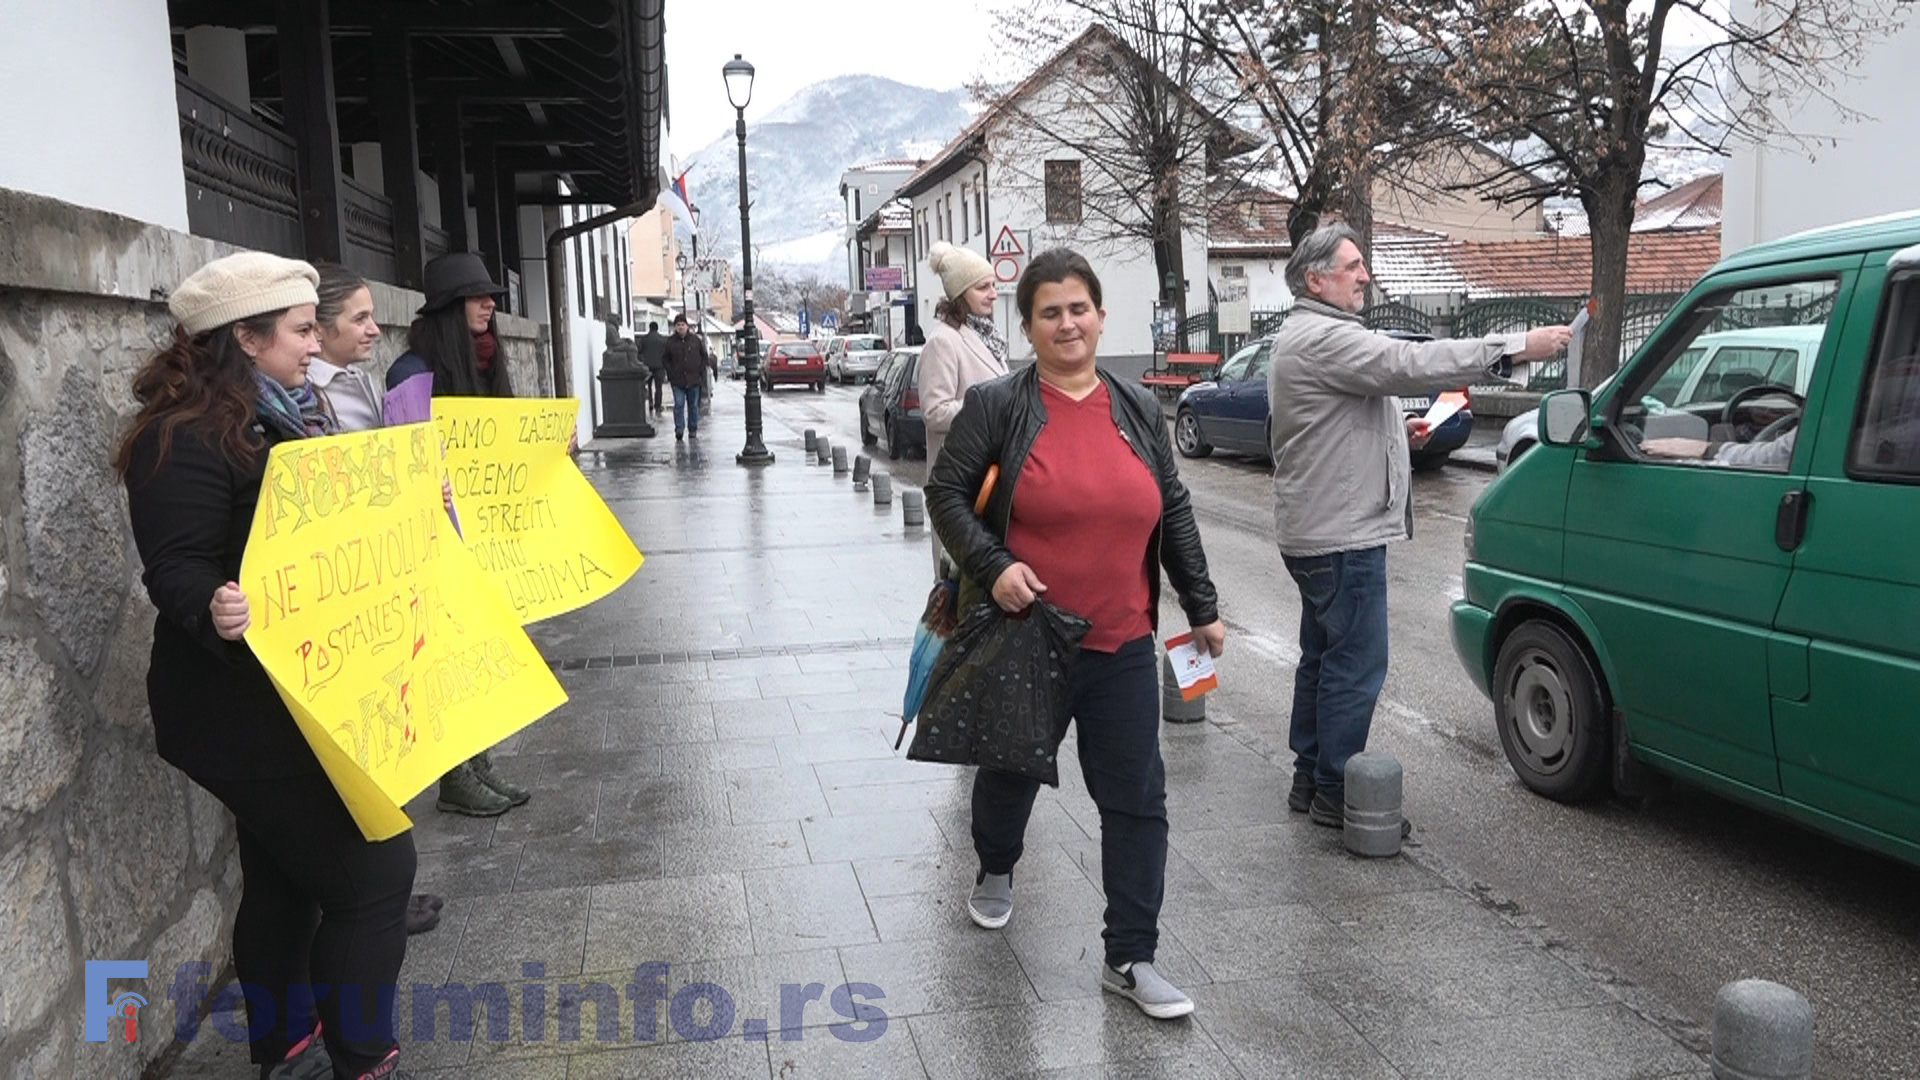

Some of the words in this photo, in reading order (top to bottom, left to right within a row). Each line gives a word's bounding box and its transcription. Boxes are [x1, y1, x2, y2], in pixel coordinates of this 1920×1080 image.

[261, 564, 300, 630] NE
[310, 517, 417, 603] DOZVOLI
[467, 537, 527, 572] OVINU
[295, 591, 405, 703] POSTANEŠ
